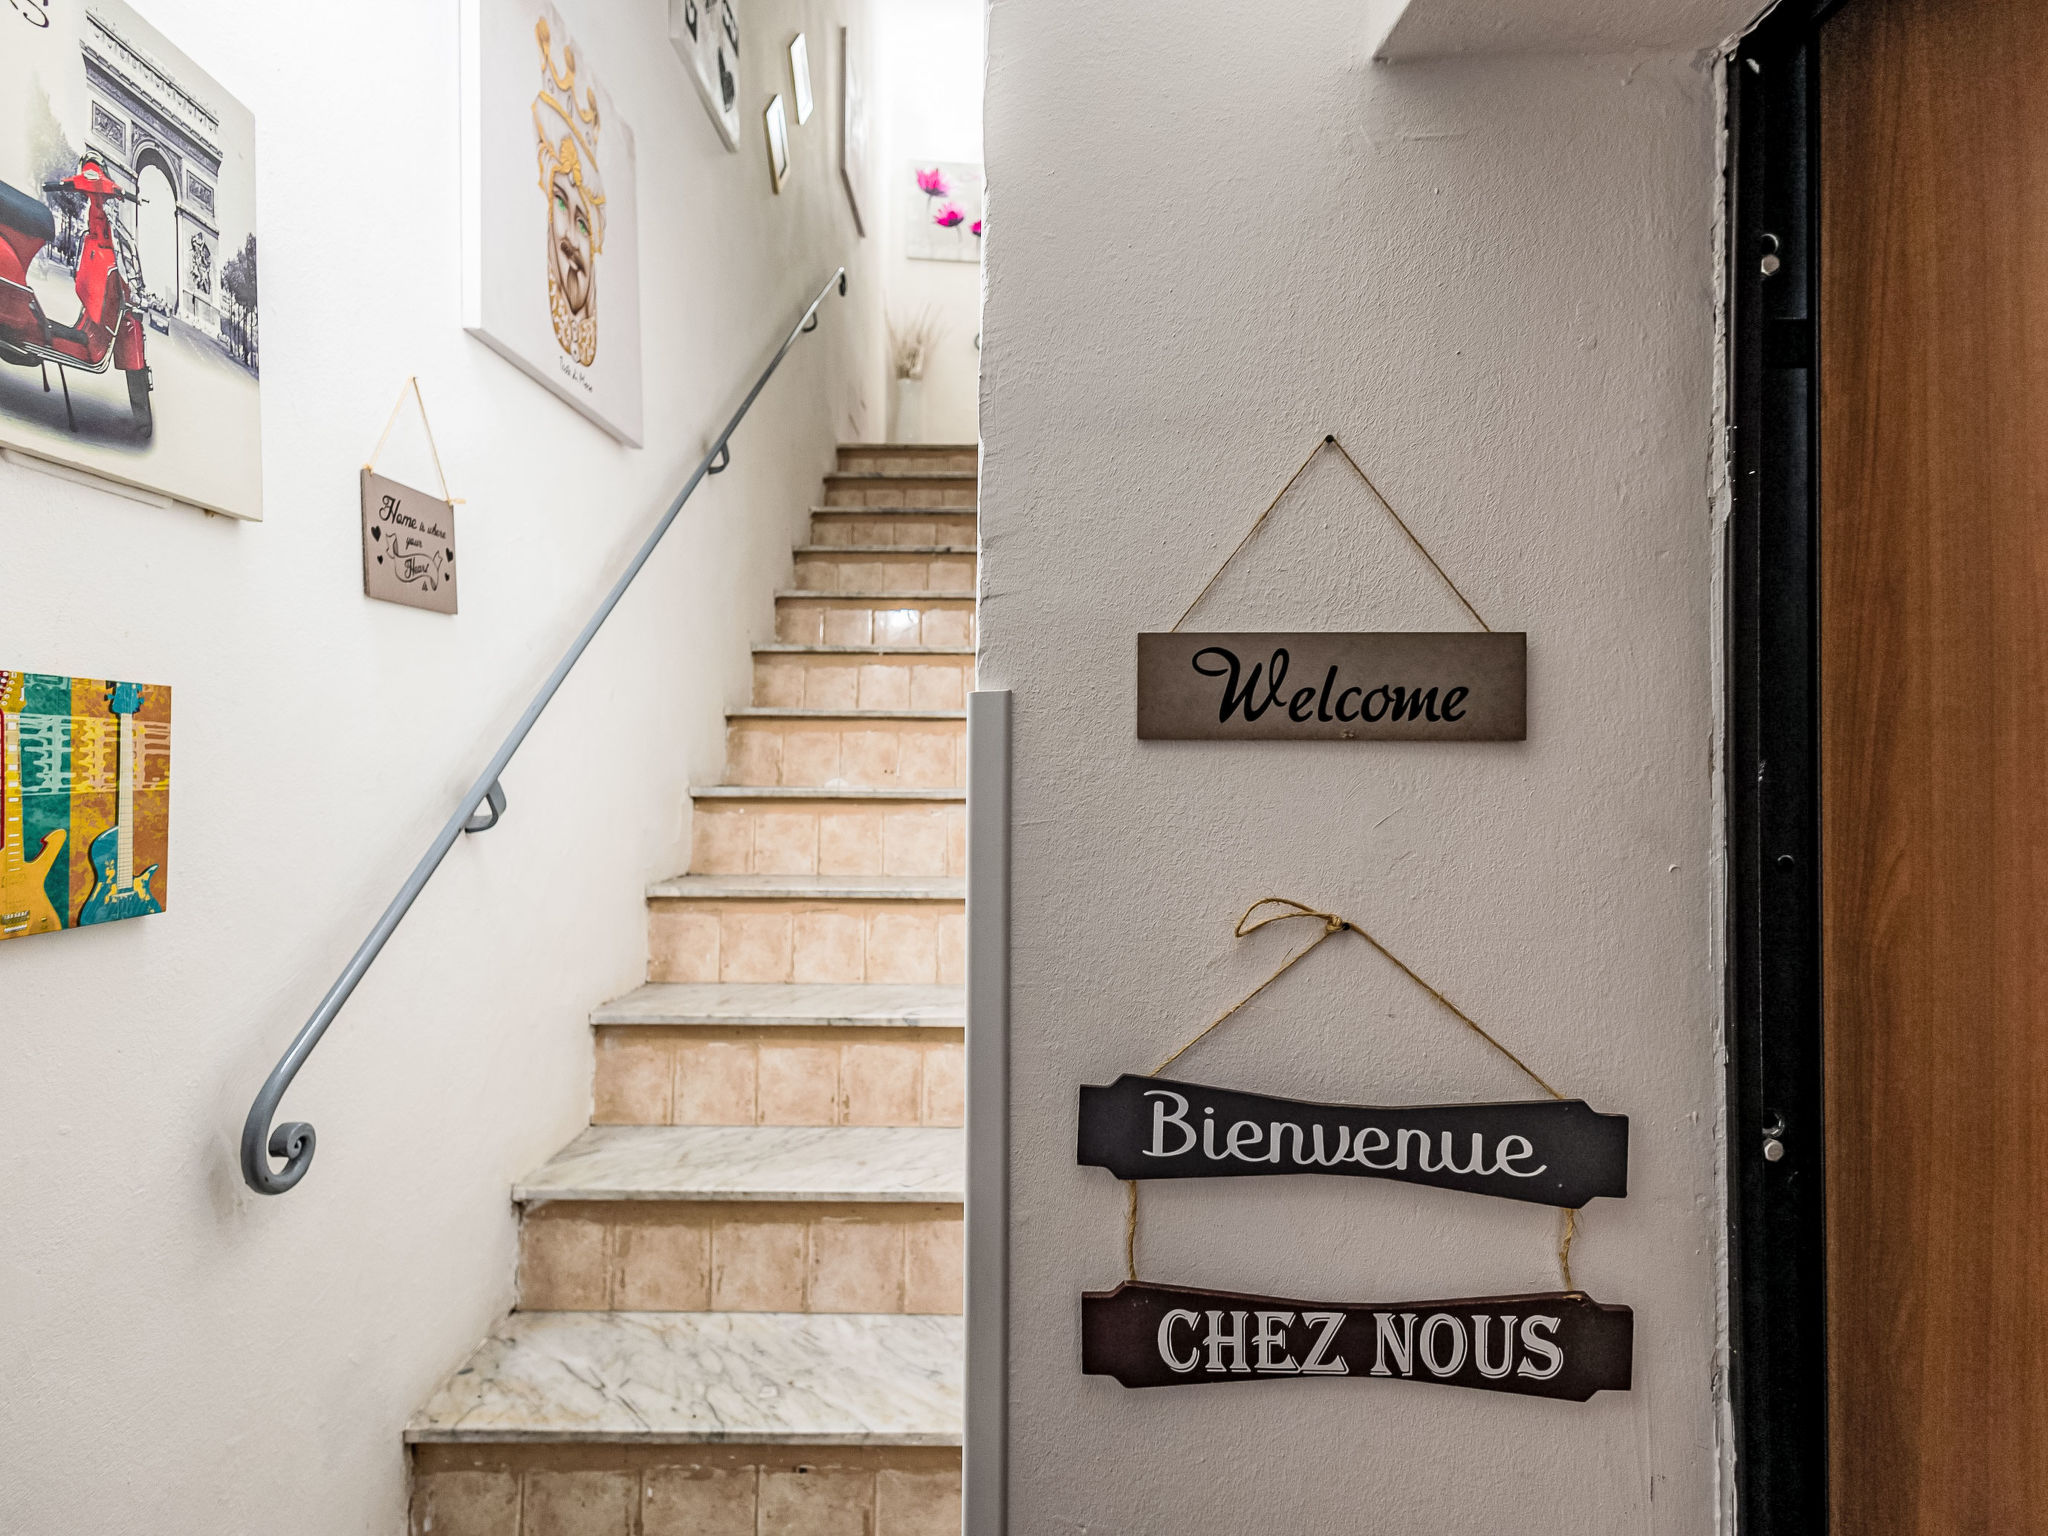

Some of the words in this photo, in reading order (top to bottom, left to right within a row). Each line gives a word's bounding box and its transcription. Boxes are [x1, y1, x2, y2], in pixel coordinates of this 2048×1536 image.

[379, 495, 417, 529] Home
[419, 522, 426, 533] is
[427, 523, 447, 540] where
[405, 536, 423, 550] your
[404, 557, 429, 580] Heart
[1192, 646, 1469, 724] Welcome
[1142, 1089, 1548, 1178] Bienvenue
[1157, 1308, 1348, 1375] CHEZ
[1370, 1312, 1565, 1380] NOUS
